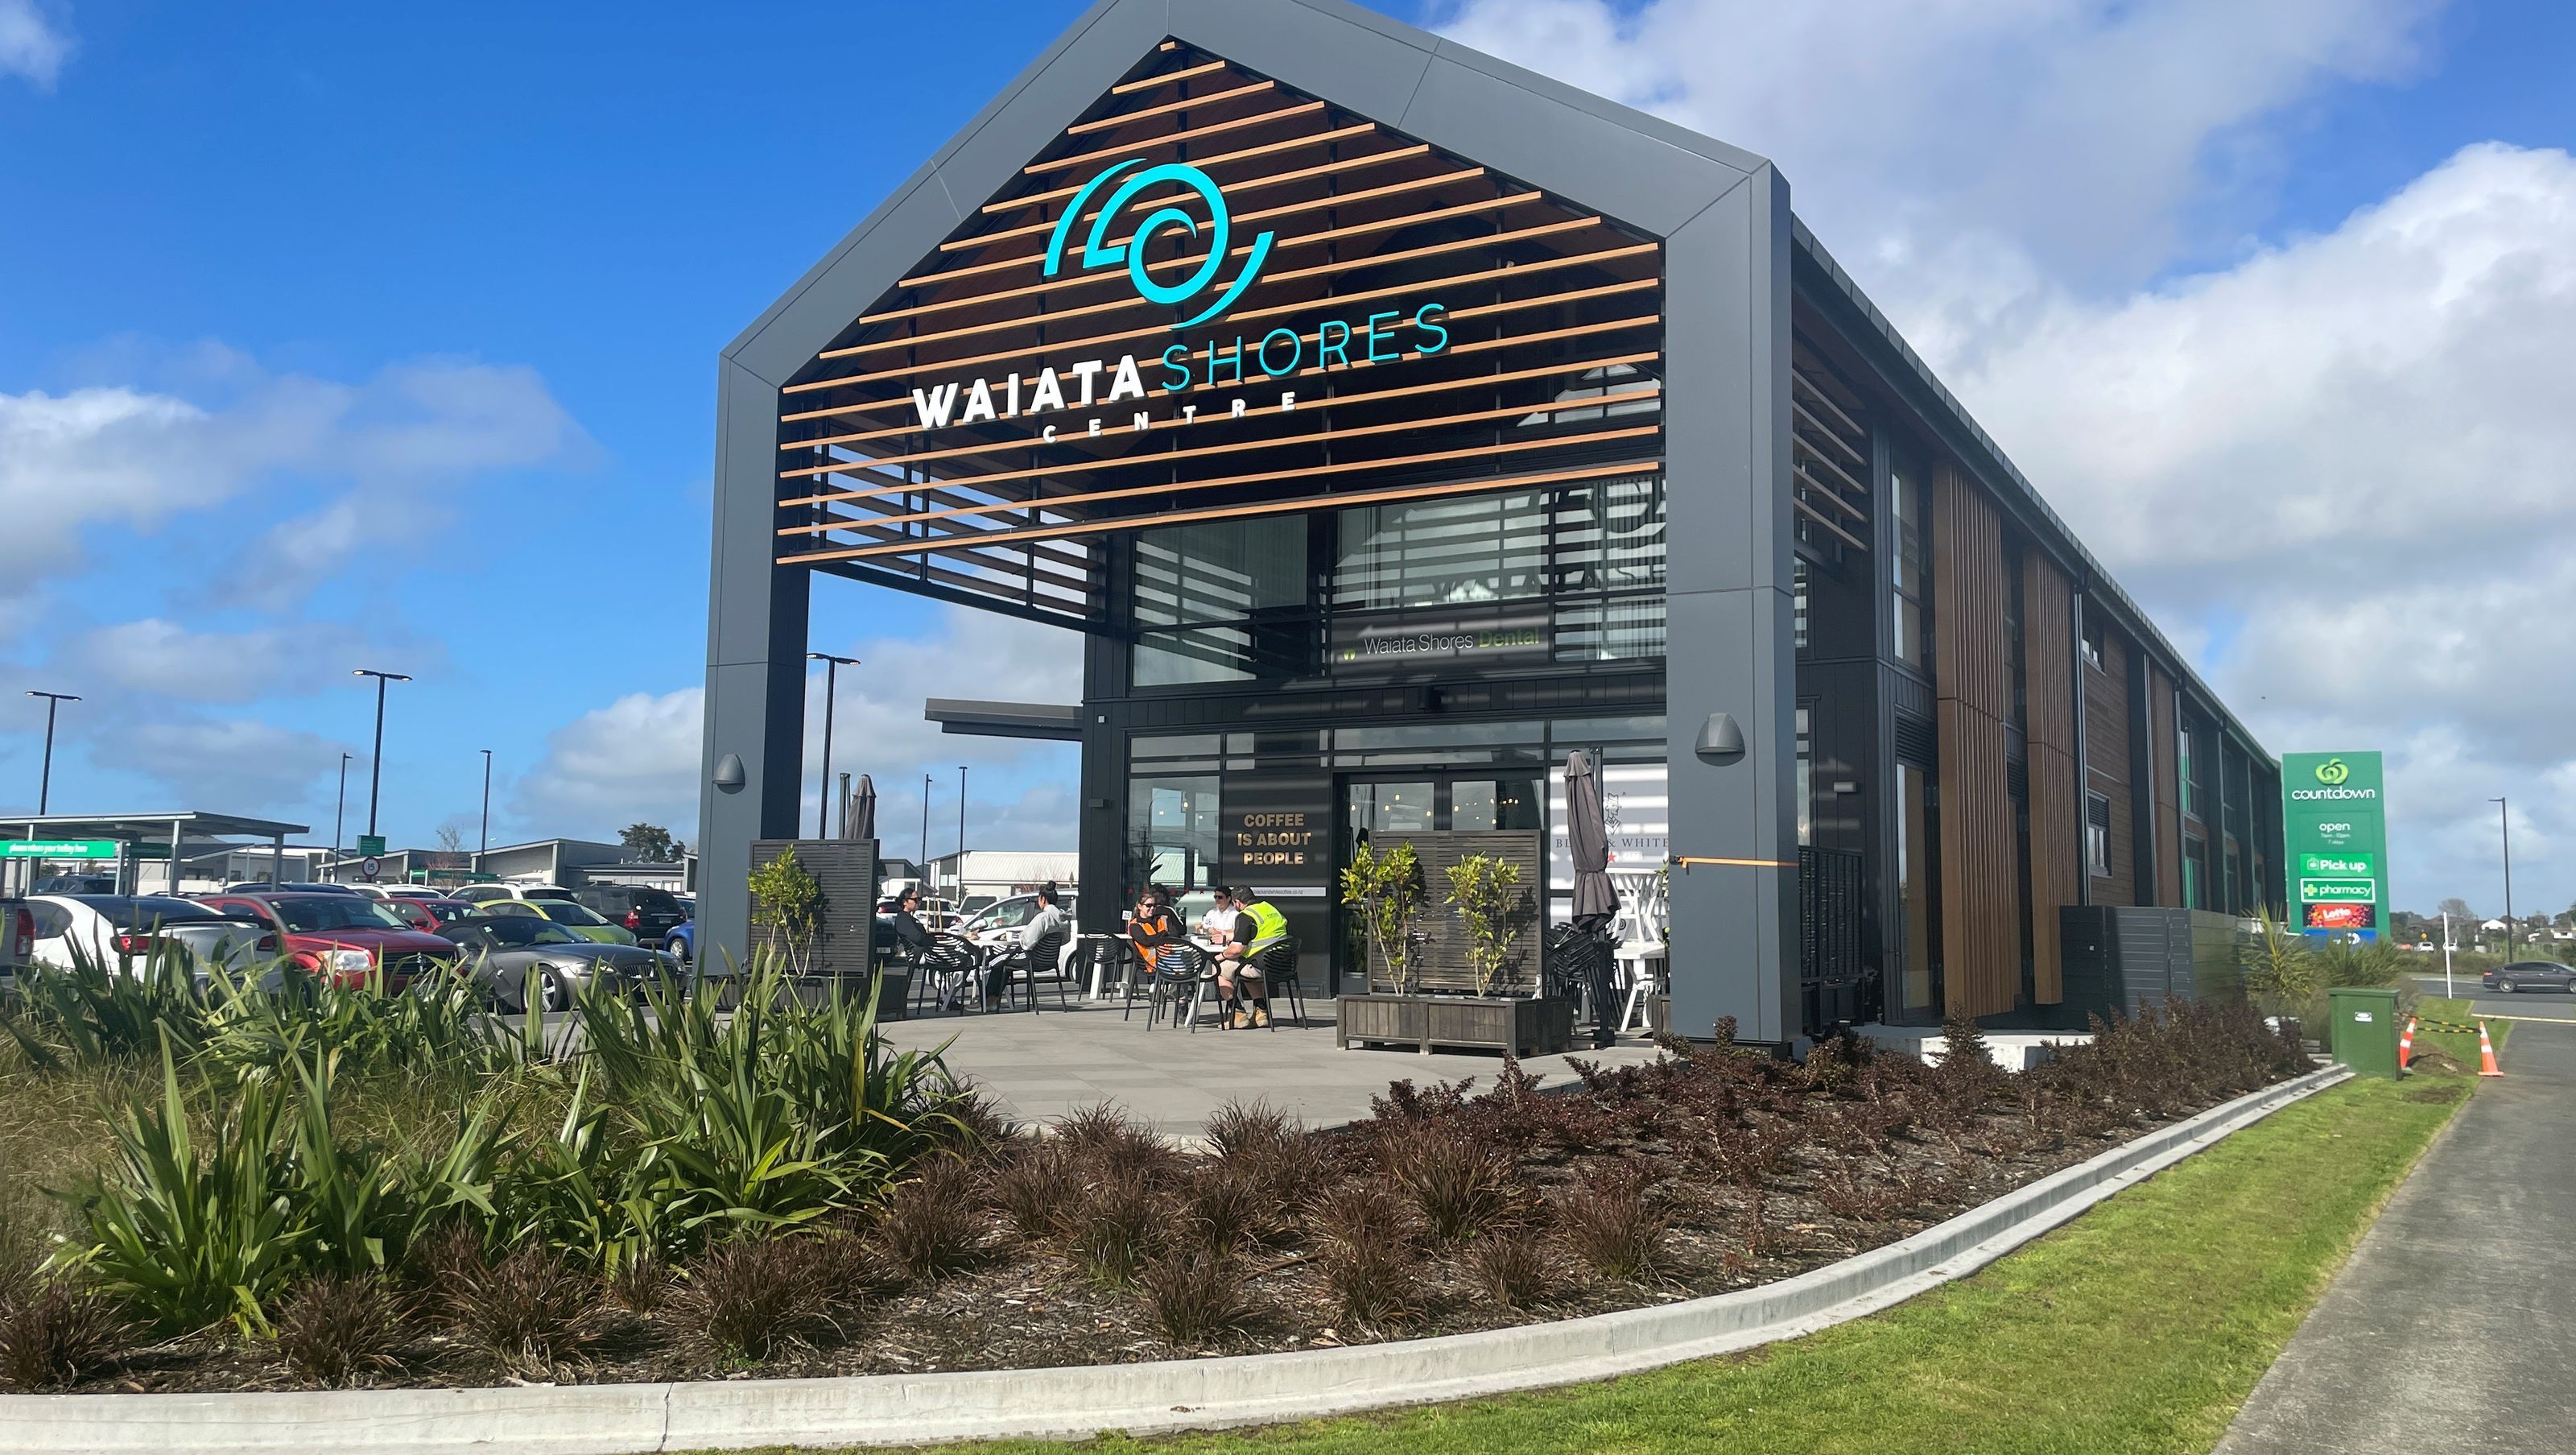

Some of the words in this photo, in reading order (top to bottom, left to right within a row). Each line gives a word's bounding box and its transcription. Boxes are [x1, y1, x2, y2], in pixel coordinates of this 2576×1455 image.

[912, 354, 1146, 429] WAIATA
[1162, 303, 1449, 392] SHORES
[1042, 391, 1297, 444] CENTRE
[1364, 636, 1416, 654] Waiata
[1418, 634, 1474, 651] Shores
[1478, 626, 1540, 647] Dental
[2291, 786, 2376, 800] countdown
[1244, 813, 1304, 827] COFFEE
[2319, 823, 2351, 833] open
[1237, 833, 1253, 846] IS
[1257, 833, 1311, 846] ABOUT
[1622, 838, 1669, 847] WHITE
[1243, 852, 1304, 865] PEOPLE
[367, 862, 375, 870] 15
[2320, 859, 2348, 870] Pick
[2349, 862, 2367, 873] up
[2319, 884, 2371, 896] pharmacy
[2322, 907, 2351, 919] Lotto
